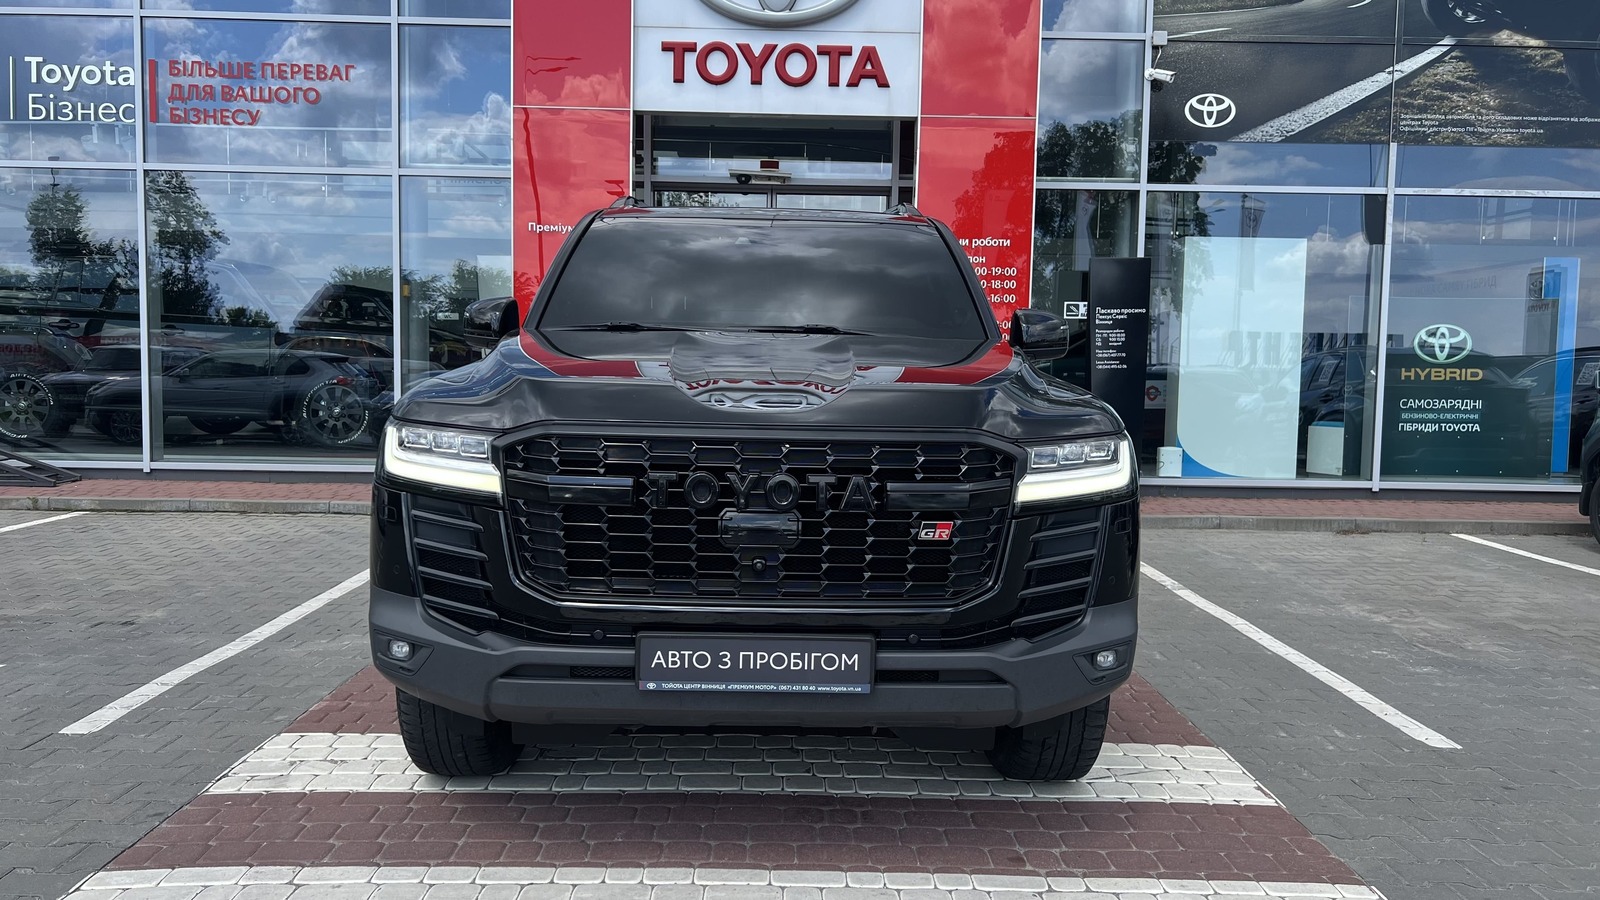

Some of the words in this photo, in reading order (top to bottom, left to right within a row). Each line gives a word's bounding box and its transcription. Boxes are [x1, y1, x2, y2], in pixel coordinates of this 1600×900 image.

[168, 60, 254, 80] БІЛЬШЕ
[261, 64, 356, 82] ПЕРЕВАГ
[661, 41, 890, 88] TOYOTA
[25, 57, 135, 91] Toyota
[168, 84, 215, 103] ДЛЯ
[221, 86, 320, 105] ВАШОГО
[28, 94, 135, 124] Бізнес
[168, 108, 261, 126] БІЗНЕСУ
[972, 236, 1011, 249] роботи
[974, 267, 1017, 277] 00-19:00
[981, 280, 1017, 289] 0-18:00
[987, 294, 1016, 303] -16:00
[1401, 367, 1484, 381] HYBRID
[1399, 398, 1482, 410] САМОЗАРЯДНІ
[1401, 412, 1479, 420] БЕНЗИНОВО-ЕЛЕКТРИЧНІ
[1398, 422, 1439, 433] ГІБРИДИ
[1440, 423, 1481, 432] TOYOTA
[648, 471, 876, 511] TOYOTA
[920, 528, 950, 538] GR
[651, 650, 711, 669] АВТО
[739, 652, 859, 672] ПРОБІГОМ
